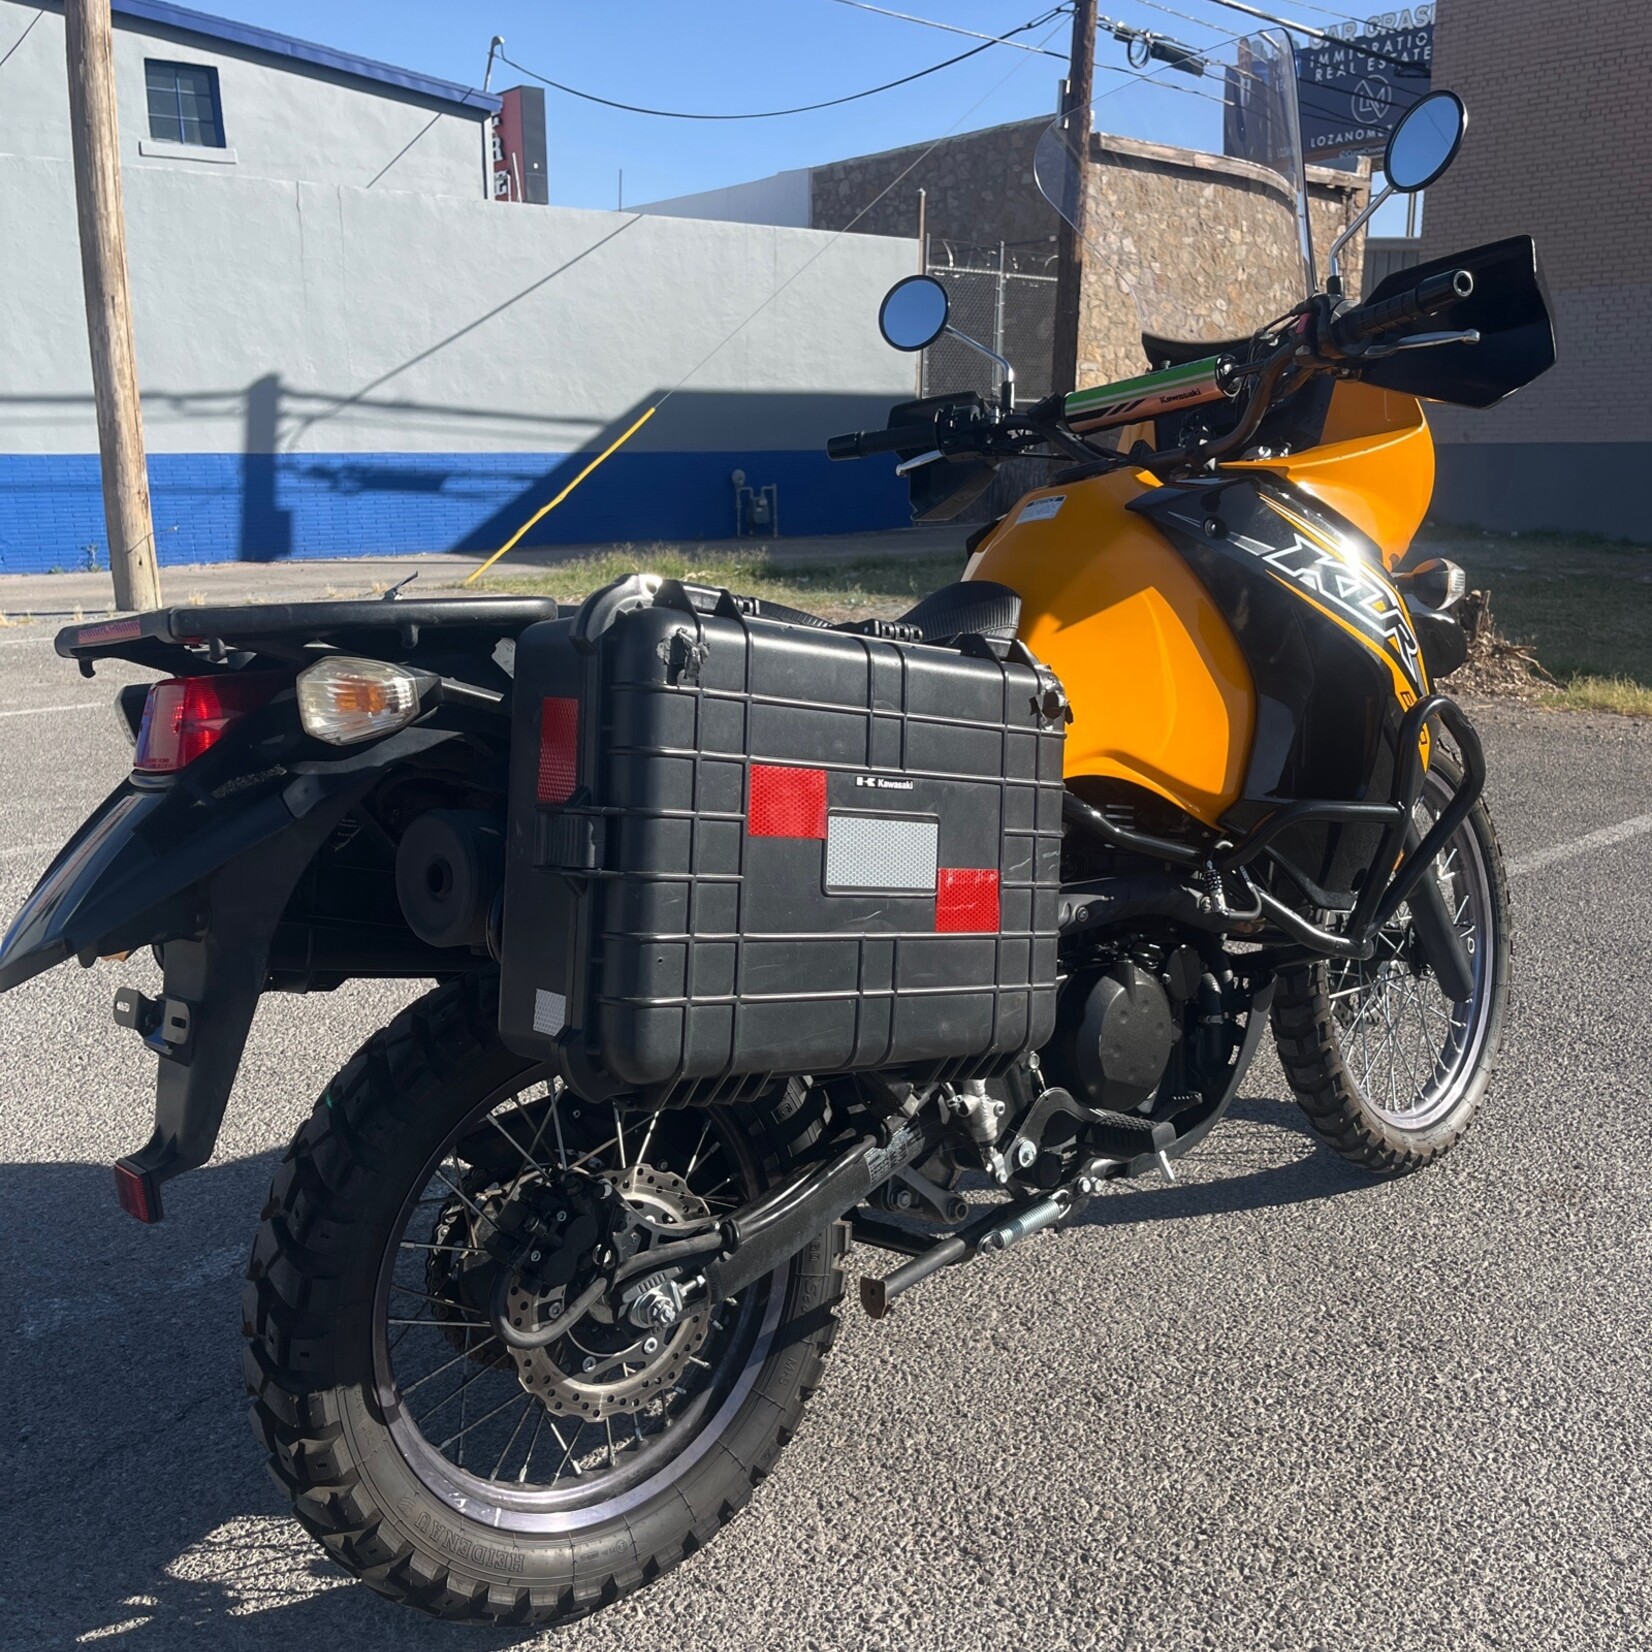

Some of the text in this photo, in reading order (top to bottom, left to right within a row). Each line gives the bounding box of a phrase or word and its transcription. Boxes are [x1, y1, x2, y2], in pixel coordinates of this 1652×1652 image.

[1308, 21, 1357, 50] CAR
[1314, 61, 1356, 82] REAL
[1159, 387, 1201, 404] Kawasaki
[877, 778, 914, 790] Kawasaki
[413, 1511, 526, 1573] HEIDENAU
